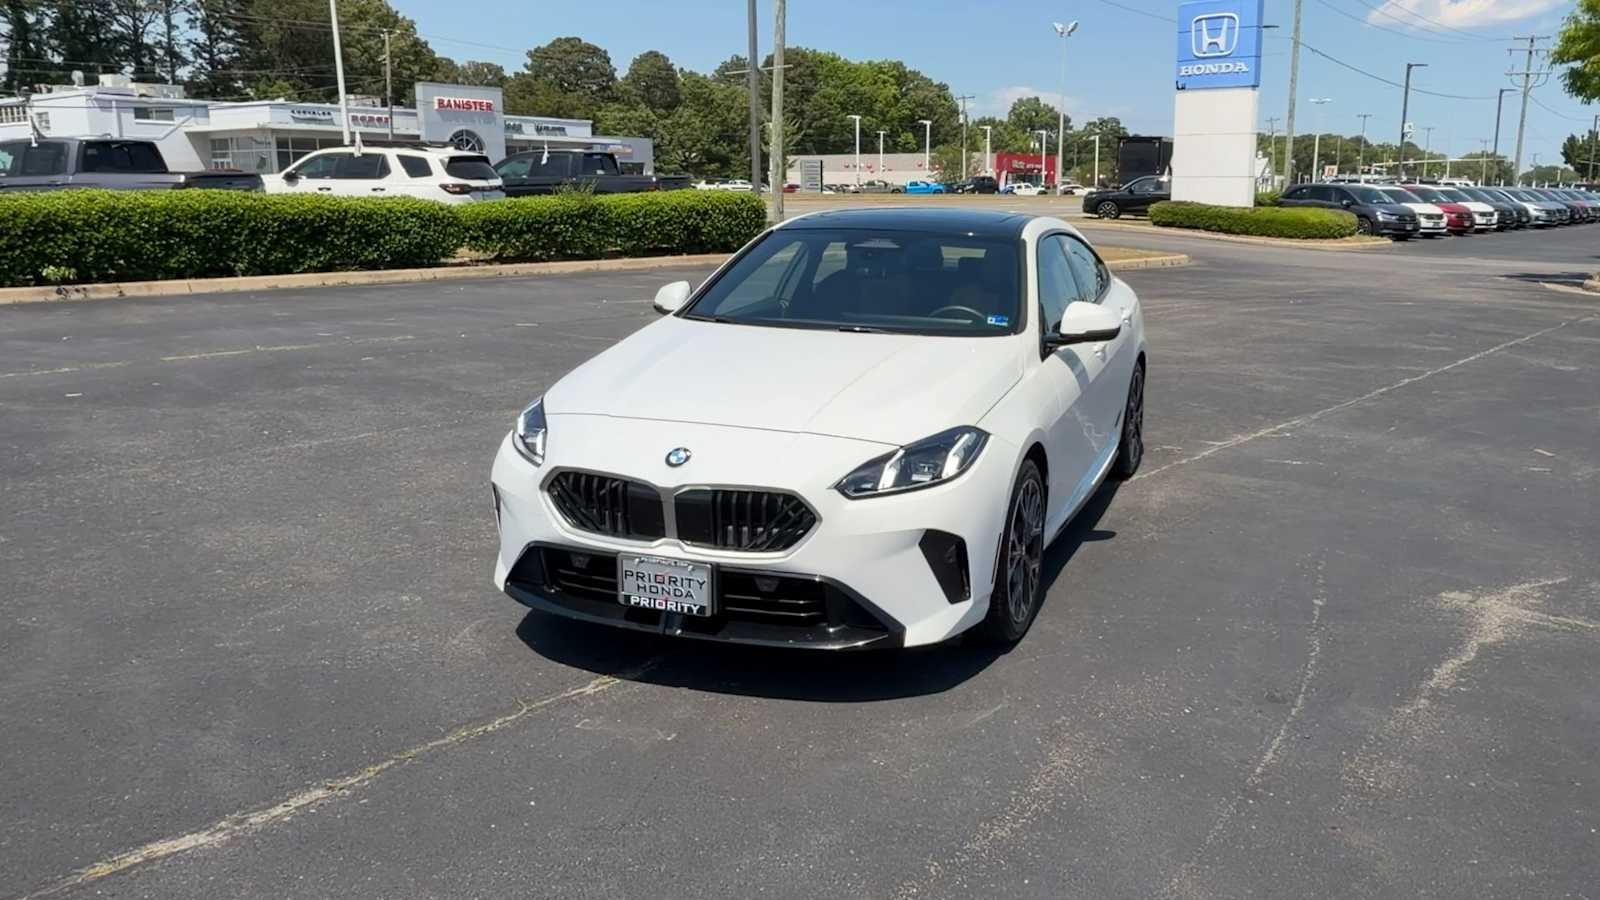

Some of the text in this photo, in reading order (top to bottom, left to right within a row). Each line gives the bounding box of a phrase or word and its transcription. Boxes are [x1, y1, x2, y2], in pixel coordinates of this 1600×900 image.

[1180, 62, 1249, 77] HONDA
[437, 98, 493, 112] BANISTER
[624, 569, 706, 590] PRIORITY
[637, 583, 696, 600] HONDA
[630, 596, 700, 614] PRIORITY
